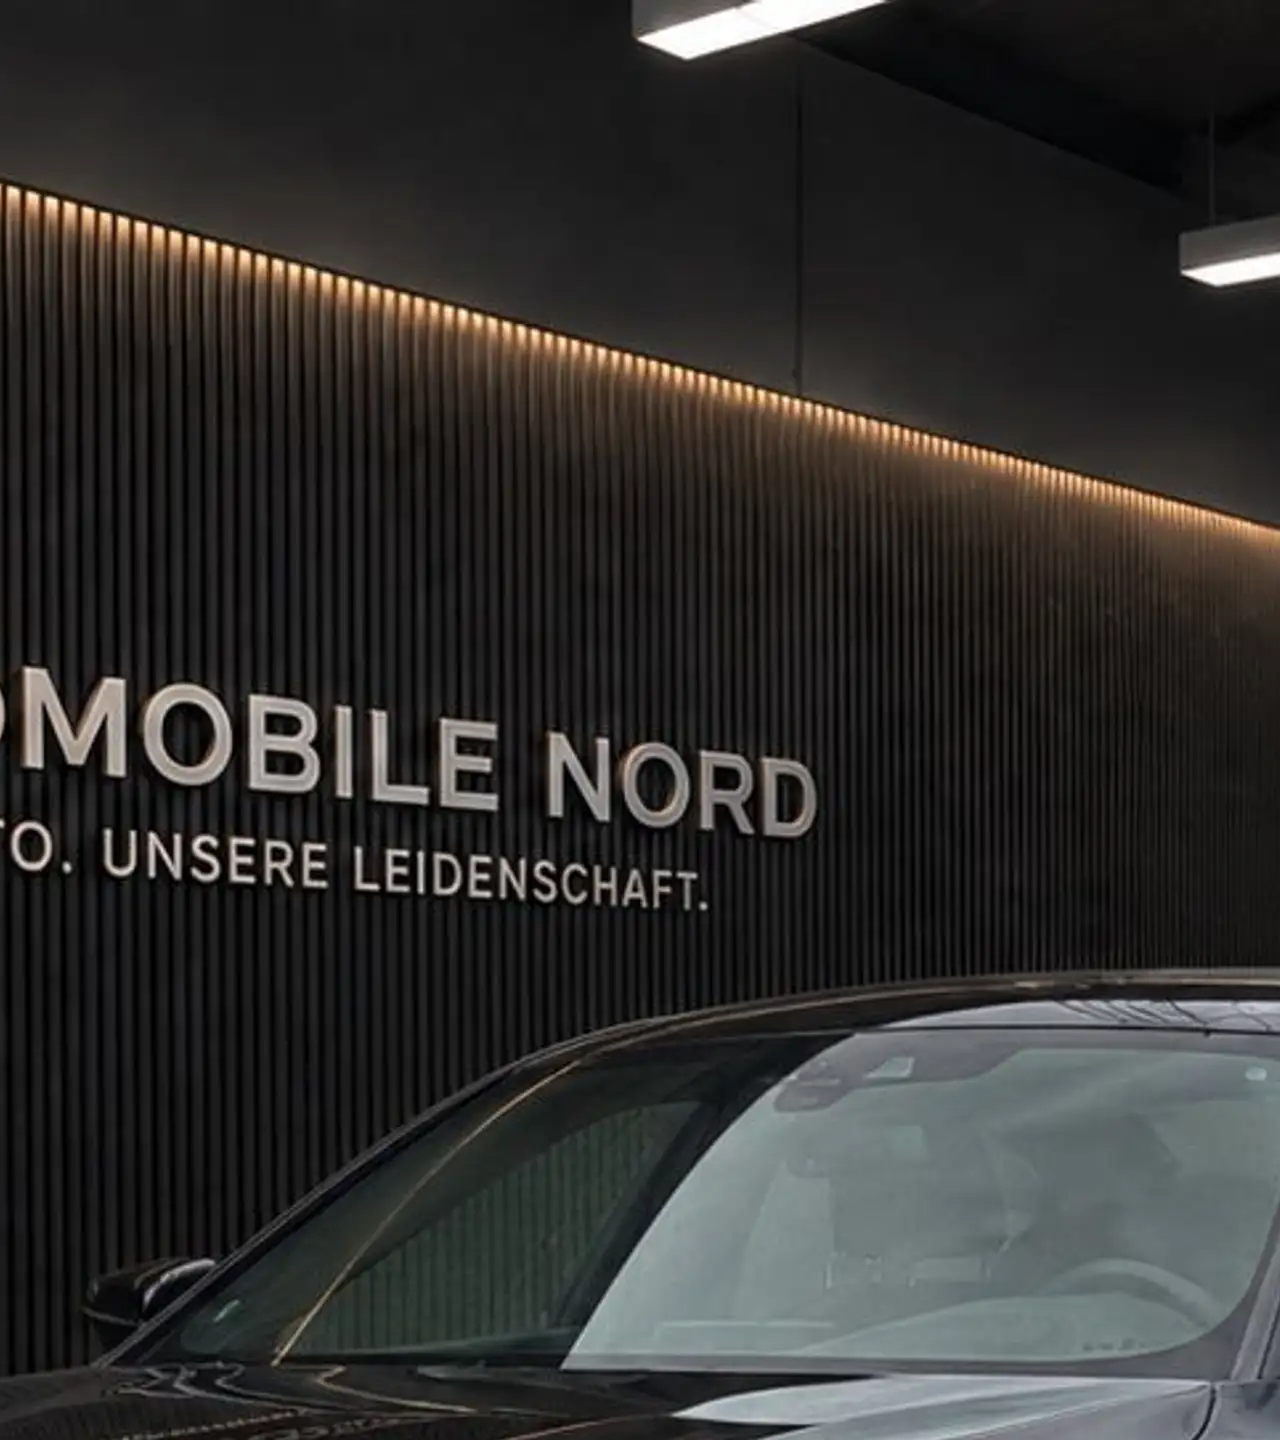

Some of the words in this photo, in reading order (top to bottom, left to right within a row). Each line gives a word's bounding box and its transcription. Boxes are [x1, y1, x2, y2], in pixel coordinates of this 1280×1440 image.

[546, 730, 818, 839] NORD
[102, 827, 330, 890] UNSERE
[353, 845, 710, 912] LEIDENSCHAFT.
